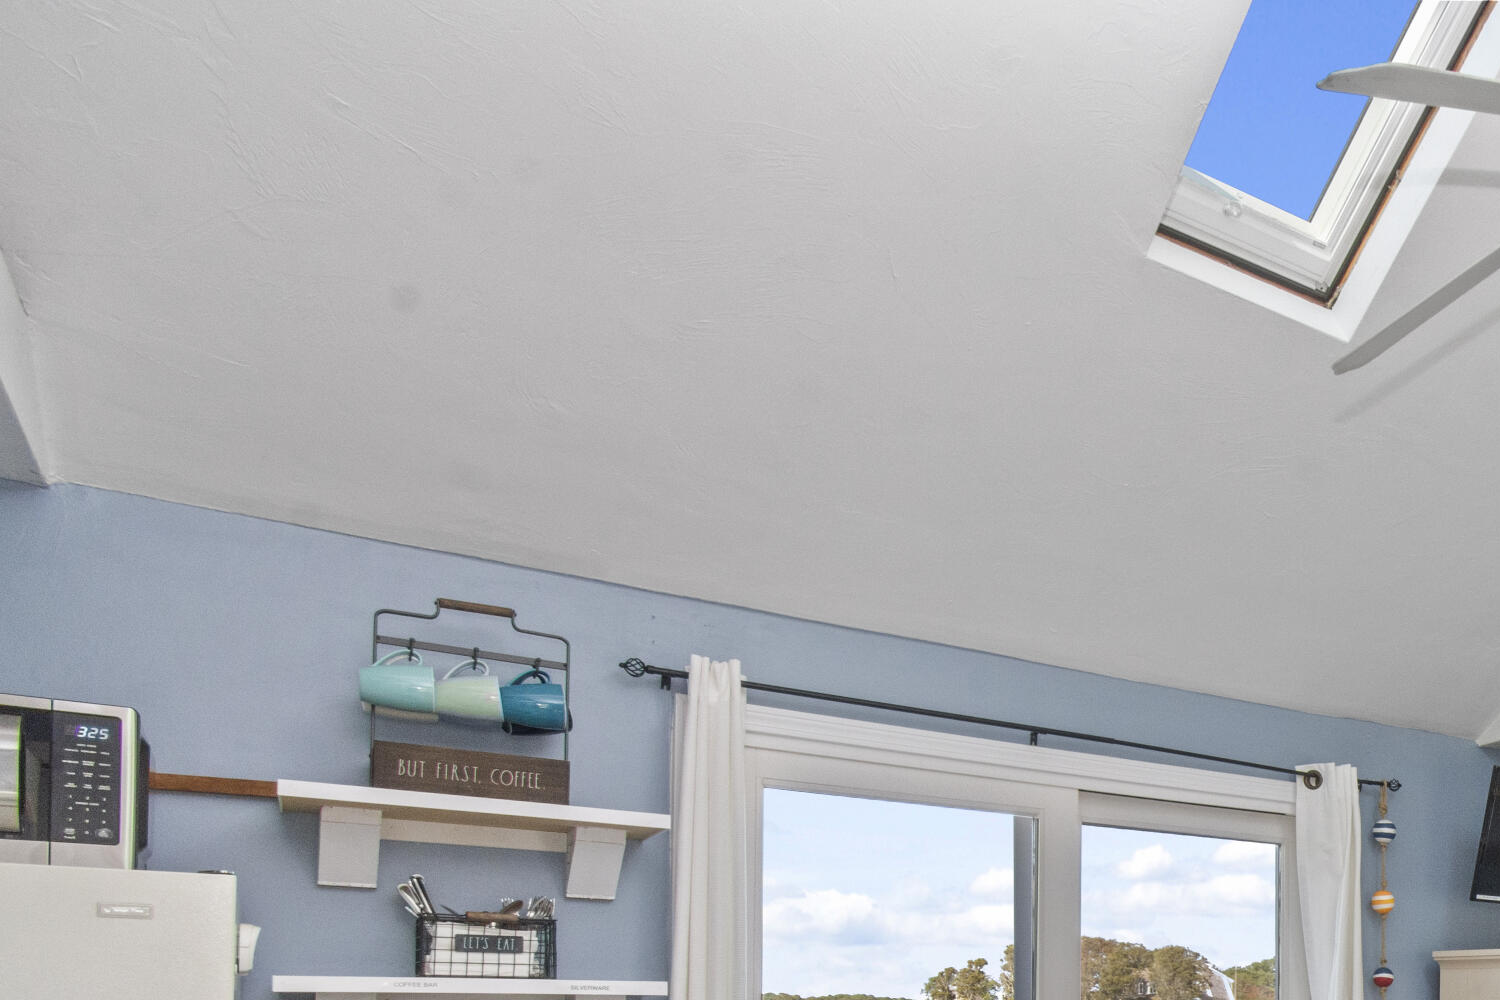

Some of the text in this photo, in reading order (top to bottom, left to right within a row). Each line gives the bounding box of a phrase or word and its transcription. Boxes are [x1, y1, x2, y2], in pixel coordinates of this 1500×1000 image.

[397, 758, 425, 779] BUT
[463, 936, 516, 951] LET'S EAT
